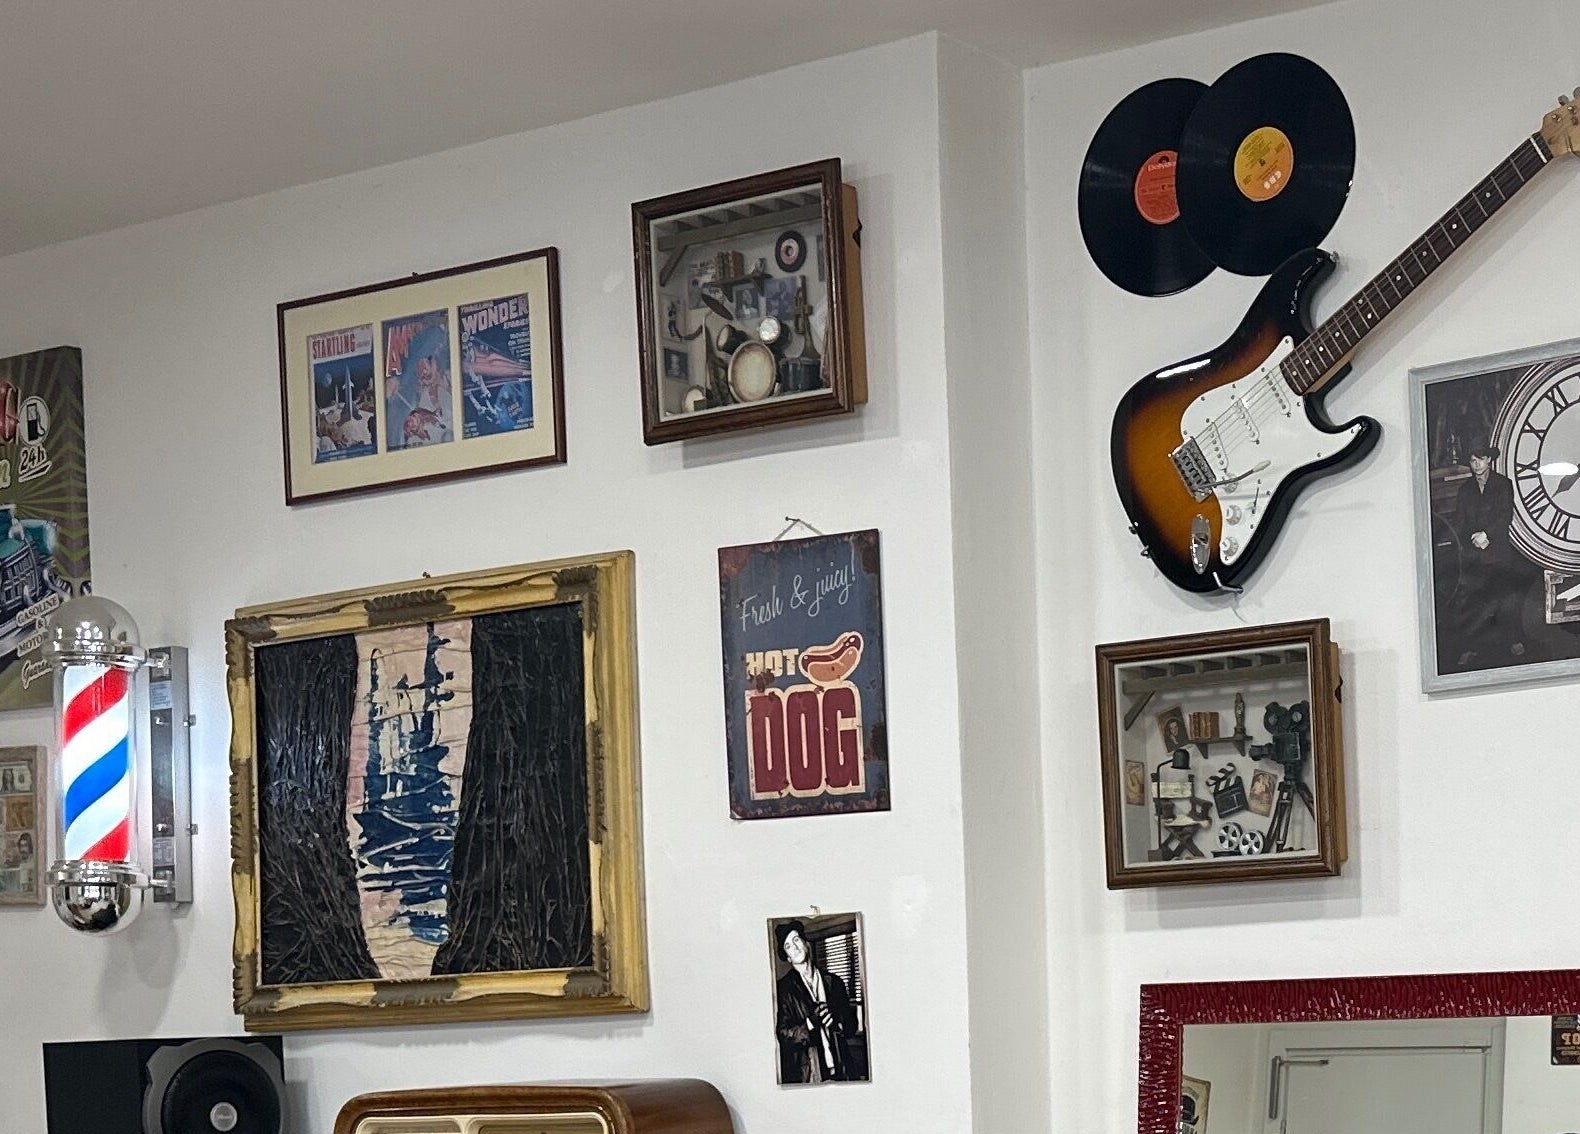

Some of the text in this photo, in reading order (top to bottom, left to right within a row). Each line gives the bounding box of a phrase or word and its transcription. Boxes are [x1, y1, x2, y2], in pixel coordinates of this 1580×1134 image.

[461, 295, 529, 335] WONDER
[312, 332, 356, 360] STARTLING
[20, 445, 46, 471] 24h
[737, 538, 856, 632] Fresh & juicy!
[18, 596, 59, 623] GASOLINE
[746, 649, 799, 680] HOT
[747, 683, 863, 798] DOG
